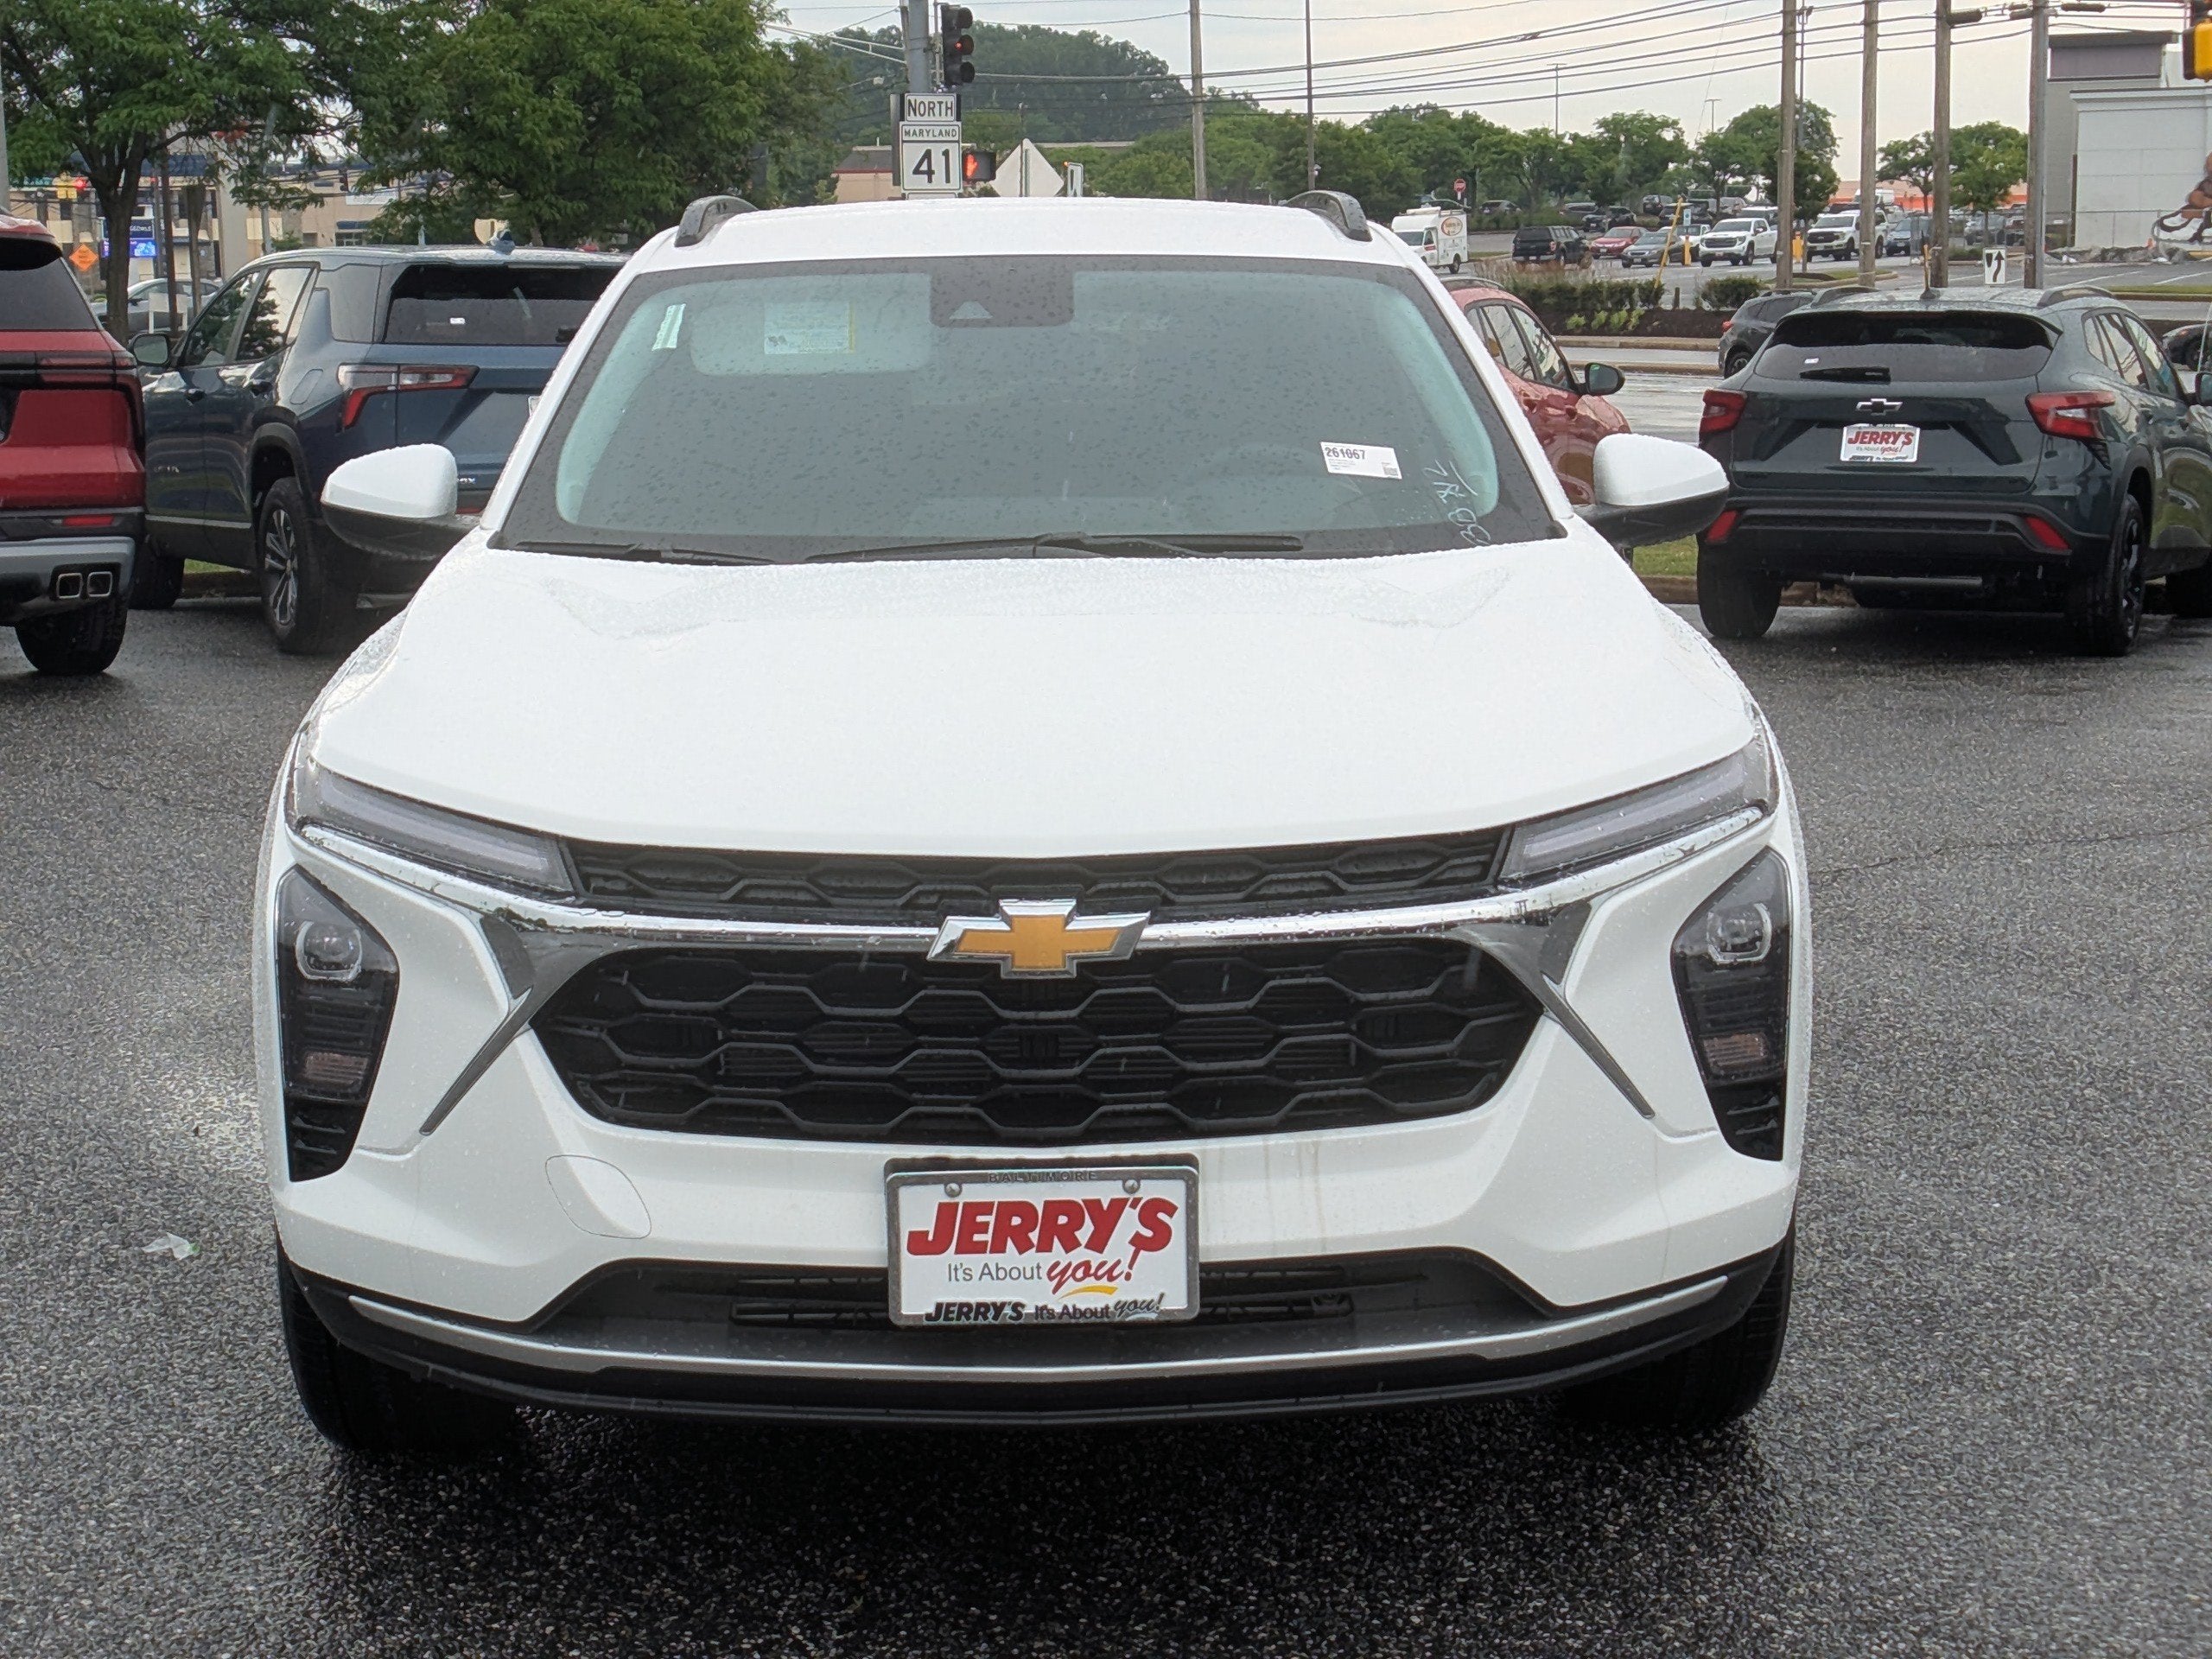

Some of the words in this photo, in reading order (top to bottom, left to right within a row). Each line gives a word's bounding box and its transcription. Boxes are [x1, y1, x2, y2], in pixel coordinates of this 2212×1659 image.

[907, 99, 953, 118] NORTH
[904, 129, 957, 138] MARYLAND
[912, 148, 950, 184] 41
[1847, 430, 1915, 446] JERRY'S
[1325, 447, 1365, 460] 261067
[988, 1171, 1097, 1183] BALTIMORE
[906, 1197, 1179, 1256] JERRY'S
[947, 1262, 974, 1282] It's
[978, 1262, 1042, 1281] About
[1046, 1249, 1142, 1295] you!
[925, 1300, 1027, 1322] JERRY'S
[1034, 1304, 1056, 1320] It's
[1059, 1303, 1111, 1320] About
[1113, 1293, 1165, 1318] you!
